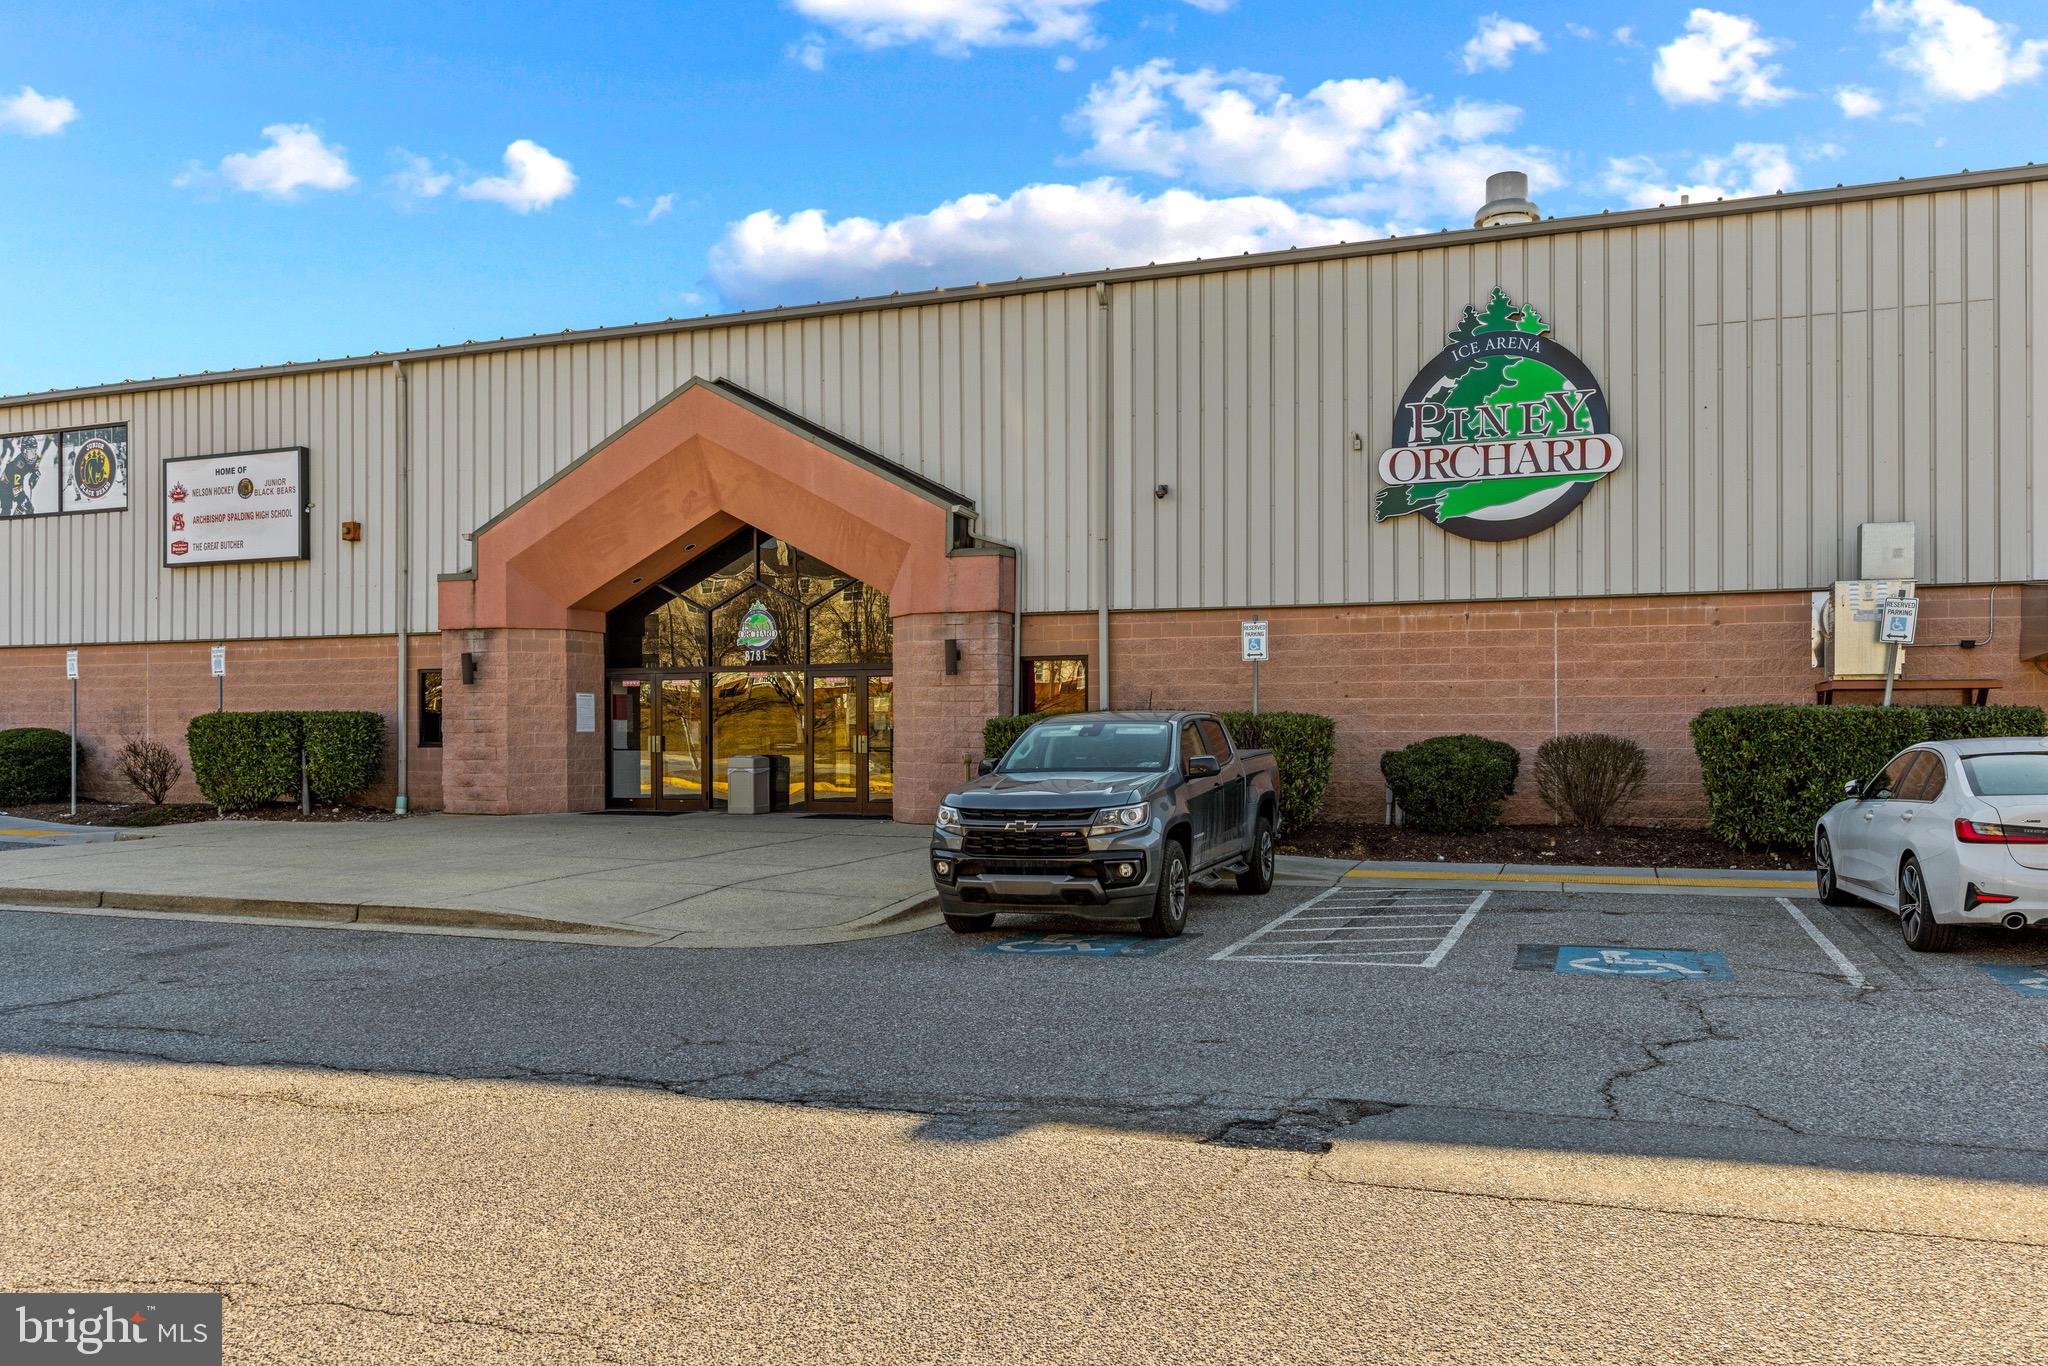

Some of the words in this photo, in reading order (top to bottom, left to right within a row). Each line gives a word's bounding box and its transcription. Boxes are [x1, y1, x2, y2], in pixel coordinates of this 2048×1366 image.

[1451, 341, 1480, 362] ICE
[1485, 336, 1541, 354] ARENA
[1405, 388, 1597, 446] PINEY
[1388, 437, 1612, 482] ORCHARD
[215, 467, 235, 476] HOME
[237, 466, 247, 474] OF
[264, 478, 286, 487] JUNIOR
[192, 487, 212, 497] NELSON
[213, 486, 234, 496] HOCKEY
[254, 487, 274, 496] BLACK
[276, 486, 296, 495] BEARS
[193, 513, 226, 525] ARCHBISHOP
[227, 511, 255, 522] SPALDING
[255, 510, 269, 520] HIGH
[270, 508, 292, 519] SCHOOL
[193, 543, 202, 551] THE
[203, 541, 219, 551] GREAT
[221, 540, 244, 550] BUTCHER
[1886, 601, 1916, 609] RESERVED
[739, 630, 777, 638] ORCHARD
[744, 650, 767, 661] 8781
